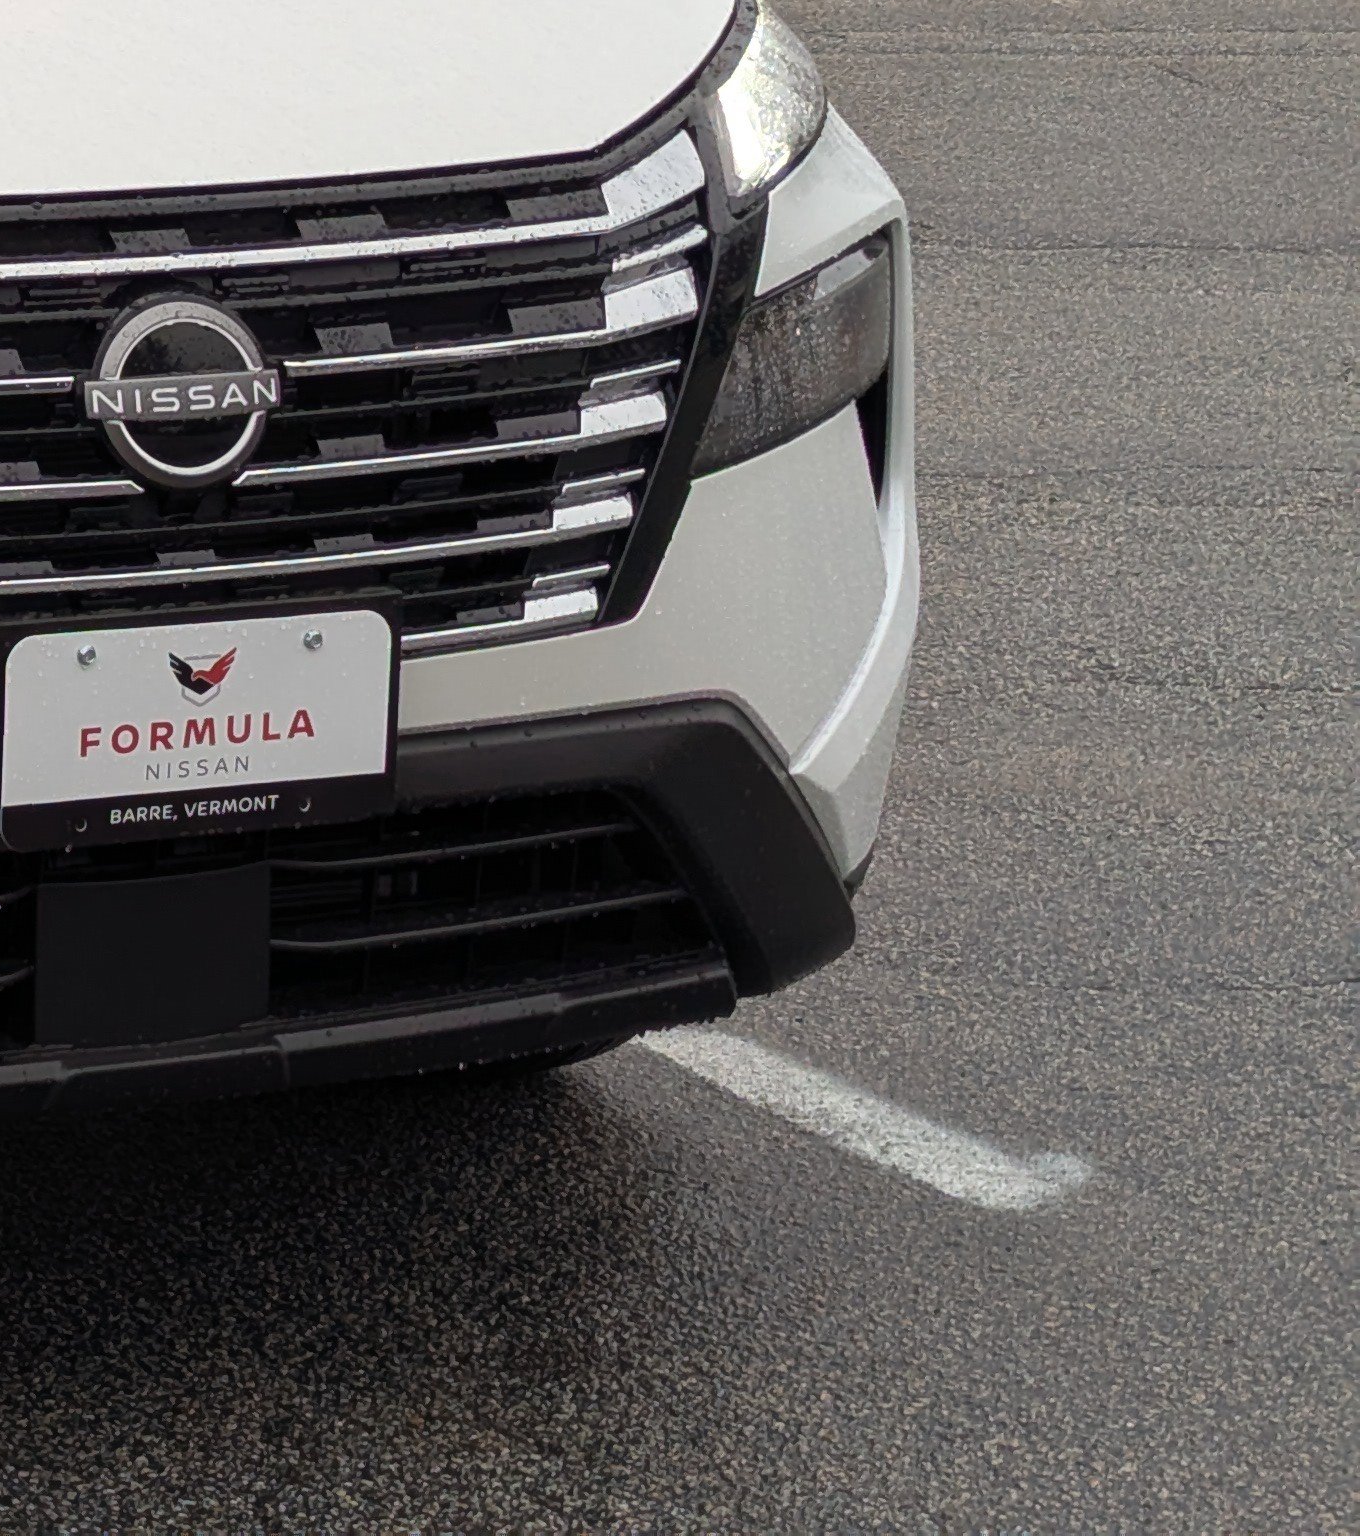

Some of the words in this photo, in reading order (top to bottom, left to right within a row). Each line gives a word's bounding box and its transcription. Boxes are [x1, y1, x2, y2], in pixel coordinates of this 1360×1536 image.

[91, 377, 277, 413] NISSAN
[79, 709, 316, 758] FORMULA
[145, 755, 249, 781] NISSAN
[109, 804, 179, 825] BARRE,
[183, 794, 280, 817] VERMONT
